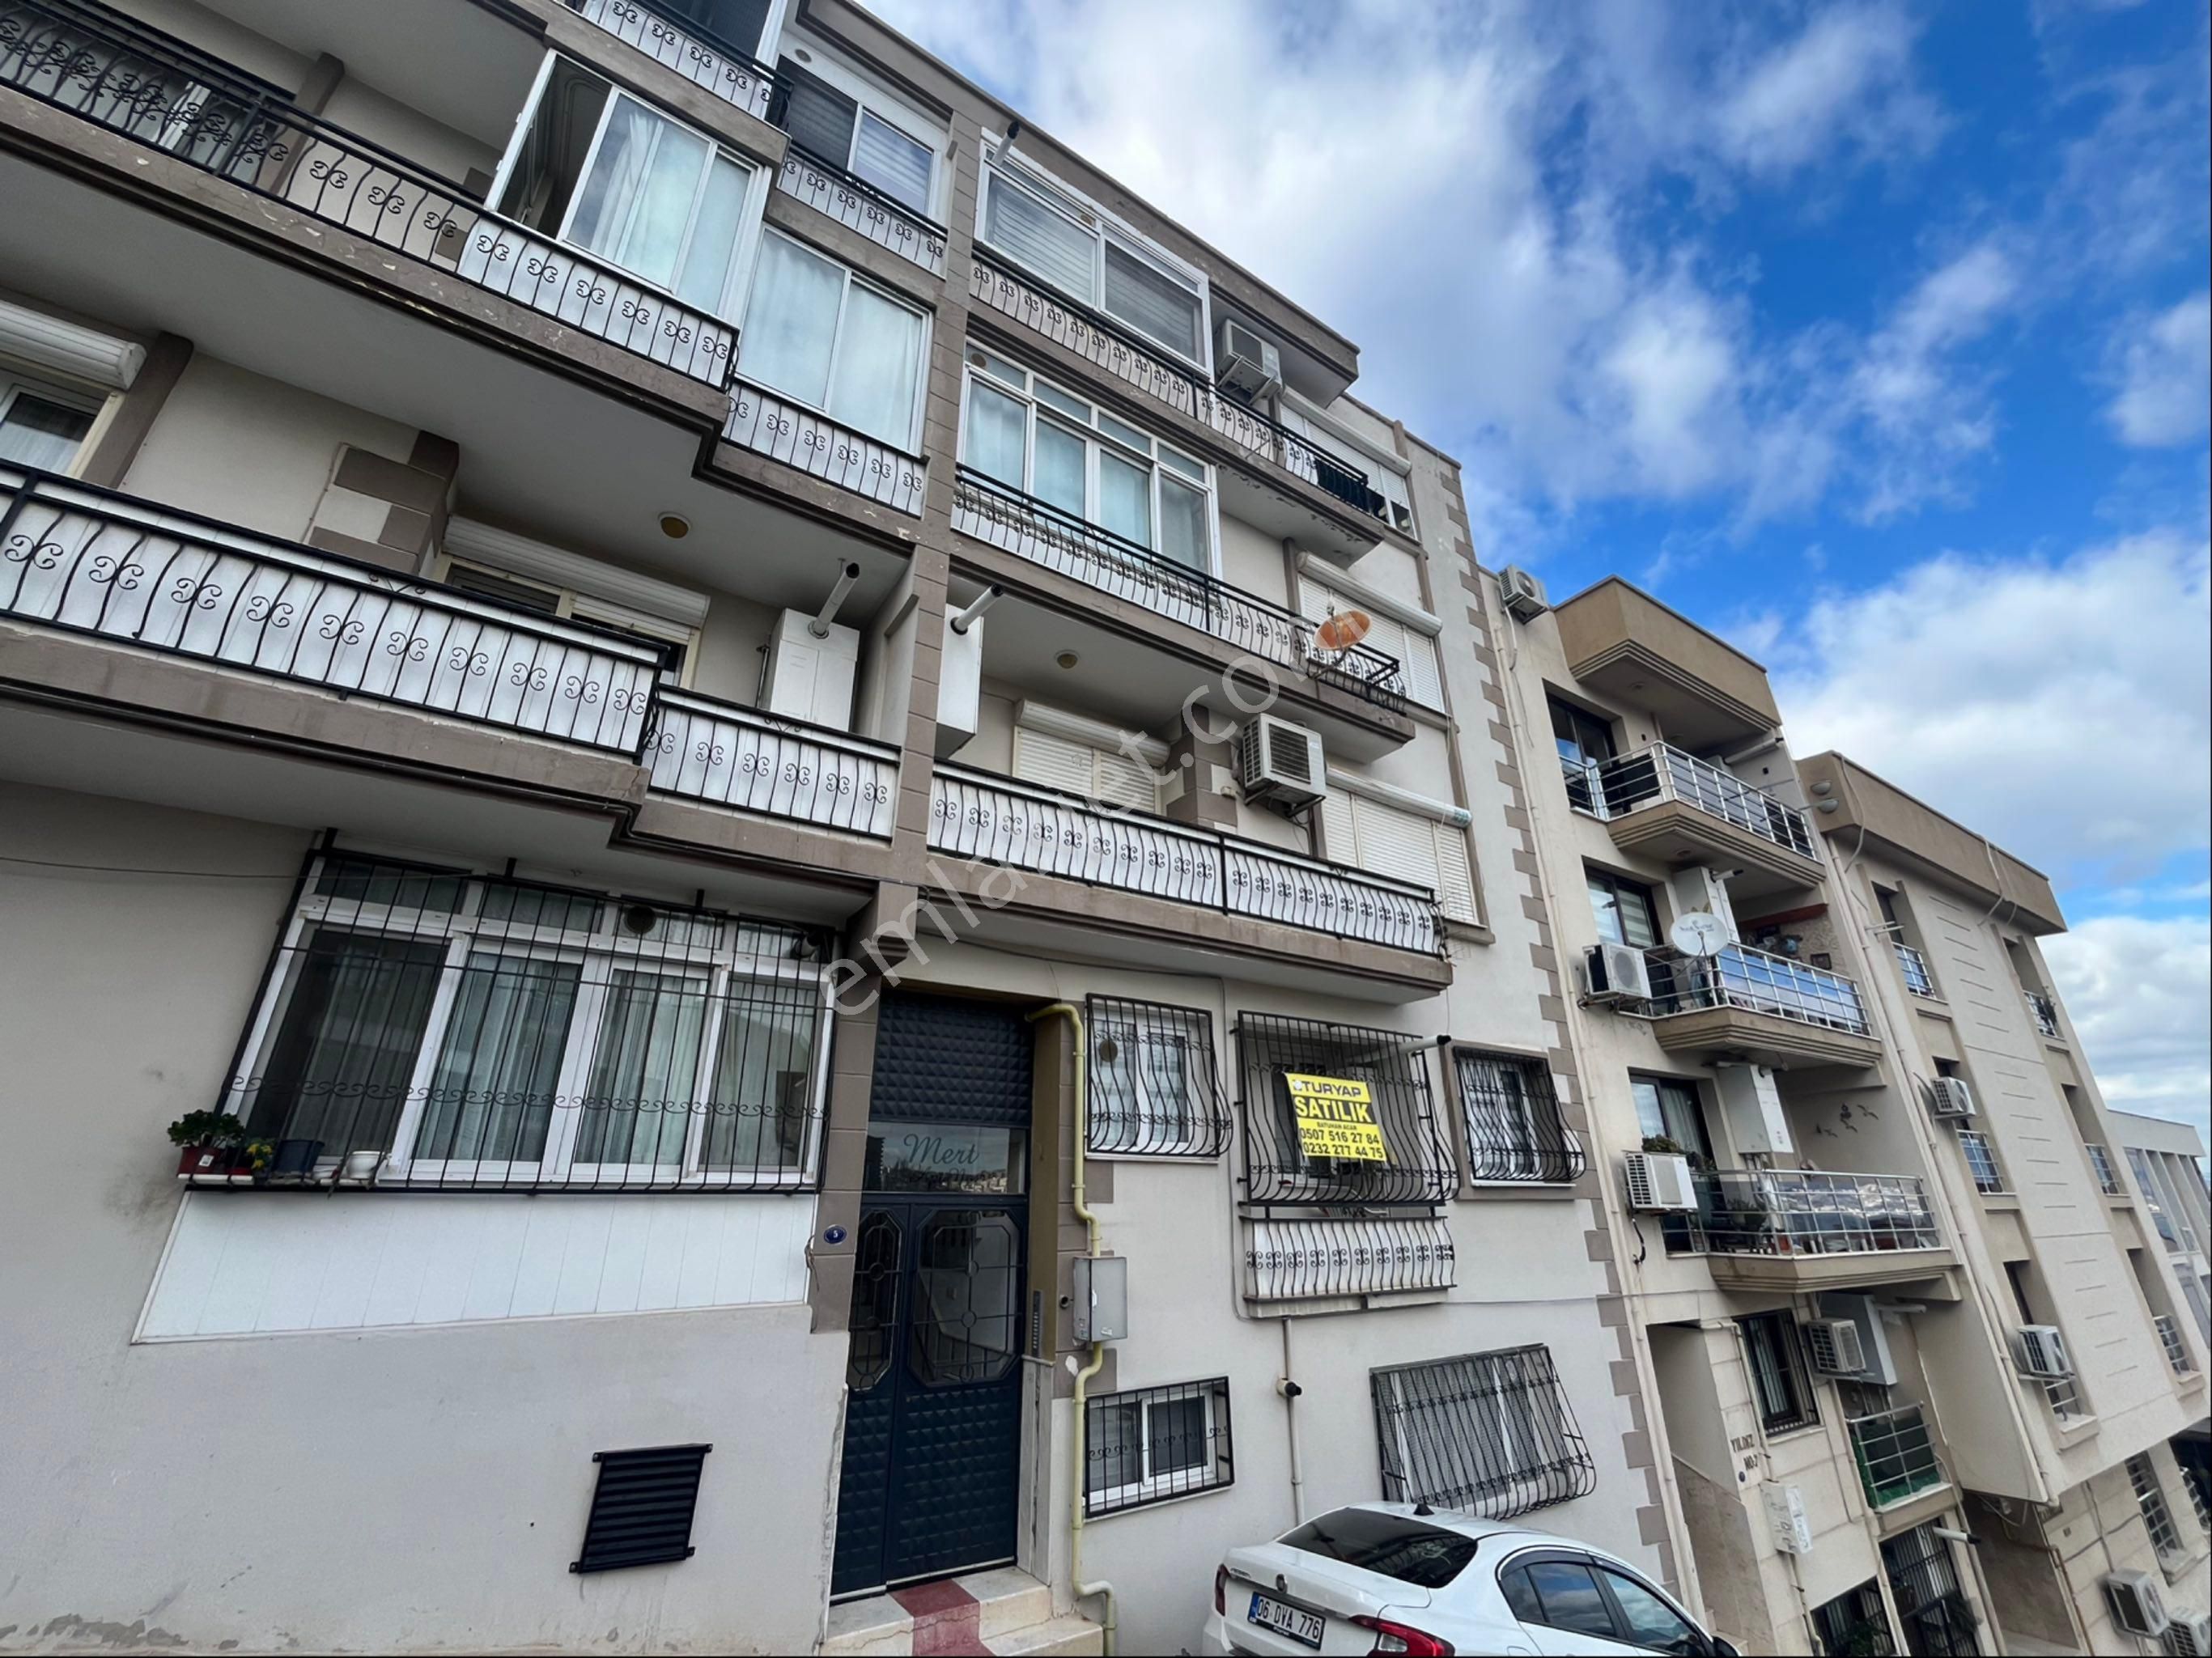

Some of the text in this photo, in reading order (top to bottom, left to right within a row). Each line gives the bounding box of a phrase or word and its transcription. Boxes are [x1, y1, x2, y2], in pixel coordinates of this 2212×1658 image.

[1301, 1081, 1361, 1096] TURYAP
[1294, 1096, 1372, 1123] SATILIK
[1299, 1127, 1379, 1144] 0507 516 27 84
[904, 1134, 980, 1164] Mert
[1303, 1142, 1383, 1159] 0232 277 44 75
[834, 1230, 839, 1238] 5
[1257, 1598, 1270, 1619] 06
[1298, 1613, 1321, 1639] 776
